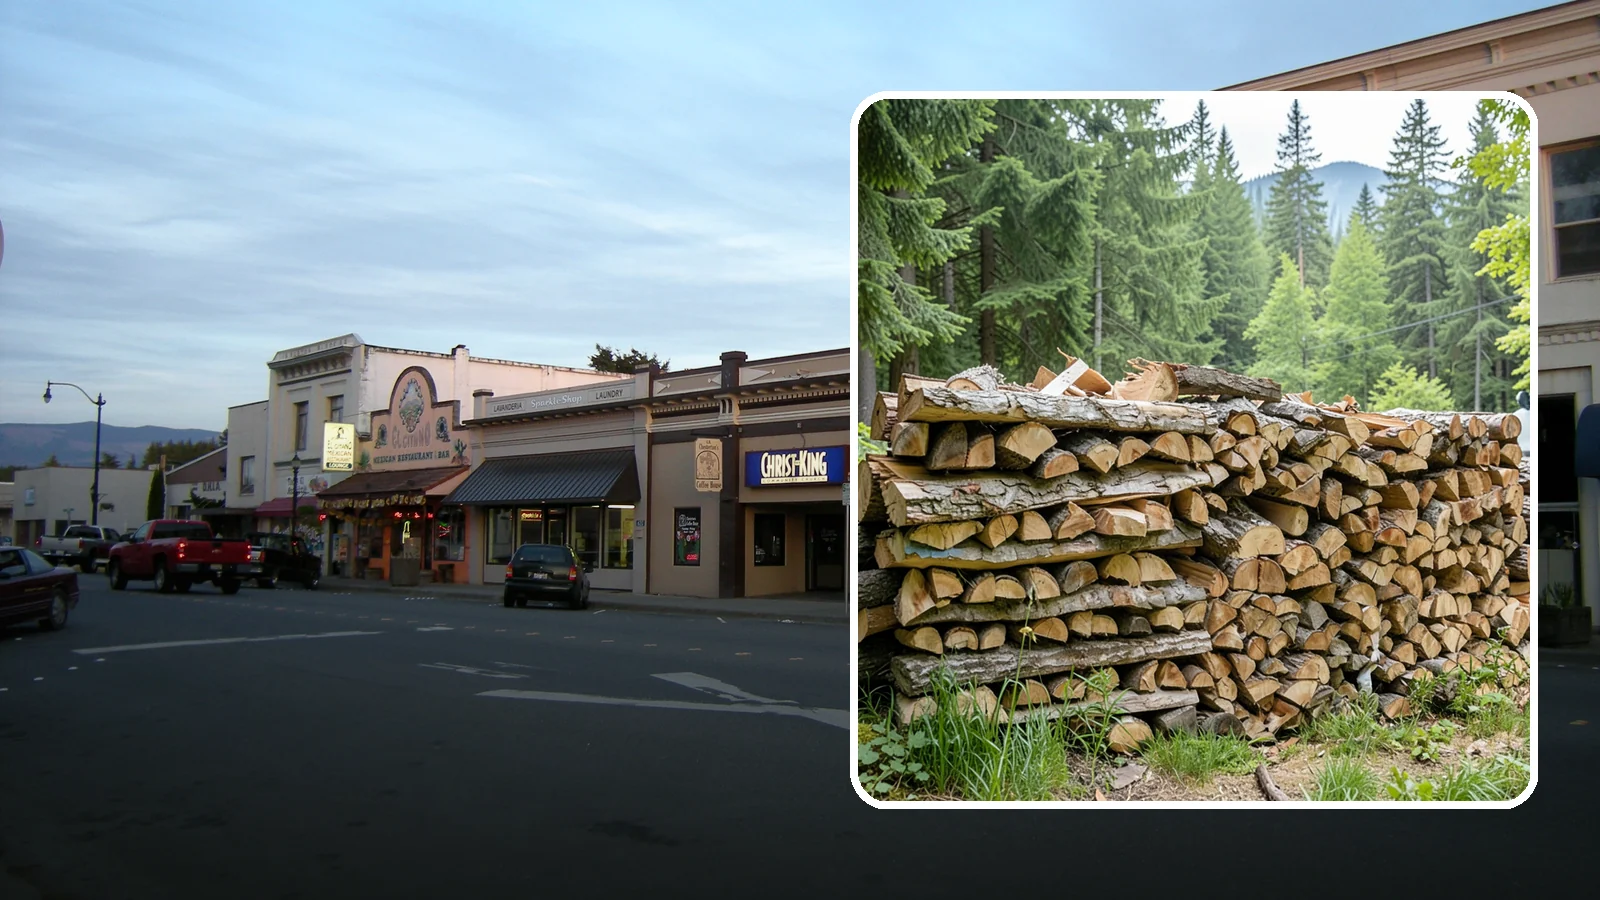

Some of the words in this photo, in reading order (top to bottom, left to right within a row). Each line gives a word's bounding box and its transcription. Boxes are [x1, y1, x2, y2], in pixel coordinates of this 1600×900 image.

[562, 394, 583, 405] Shop
[596, 388, 623, 400] LAUNDRY
[494, 402, 522, 413] LAVANDERIA
[373, 455, 396, 464] MEXICAN
[398, 451, 433, 462] RESTAURANT
[438, 450, 449, 459] BAR
[761, 452, 797, 478] CHRIST
[800, 450, 827, 476] KING
